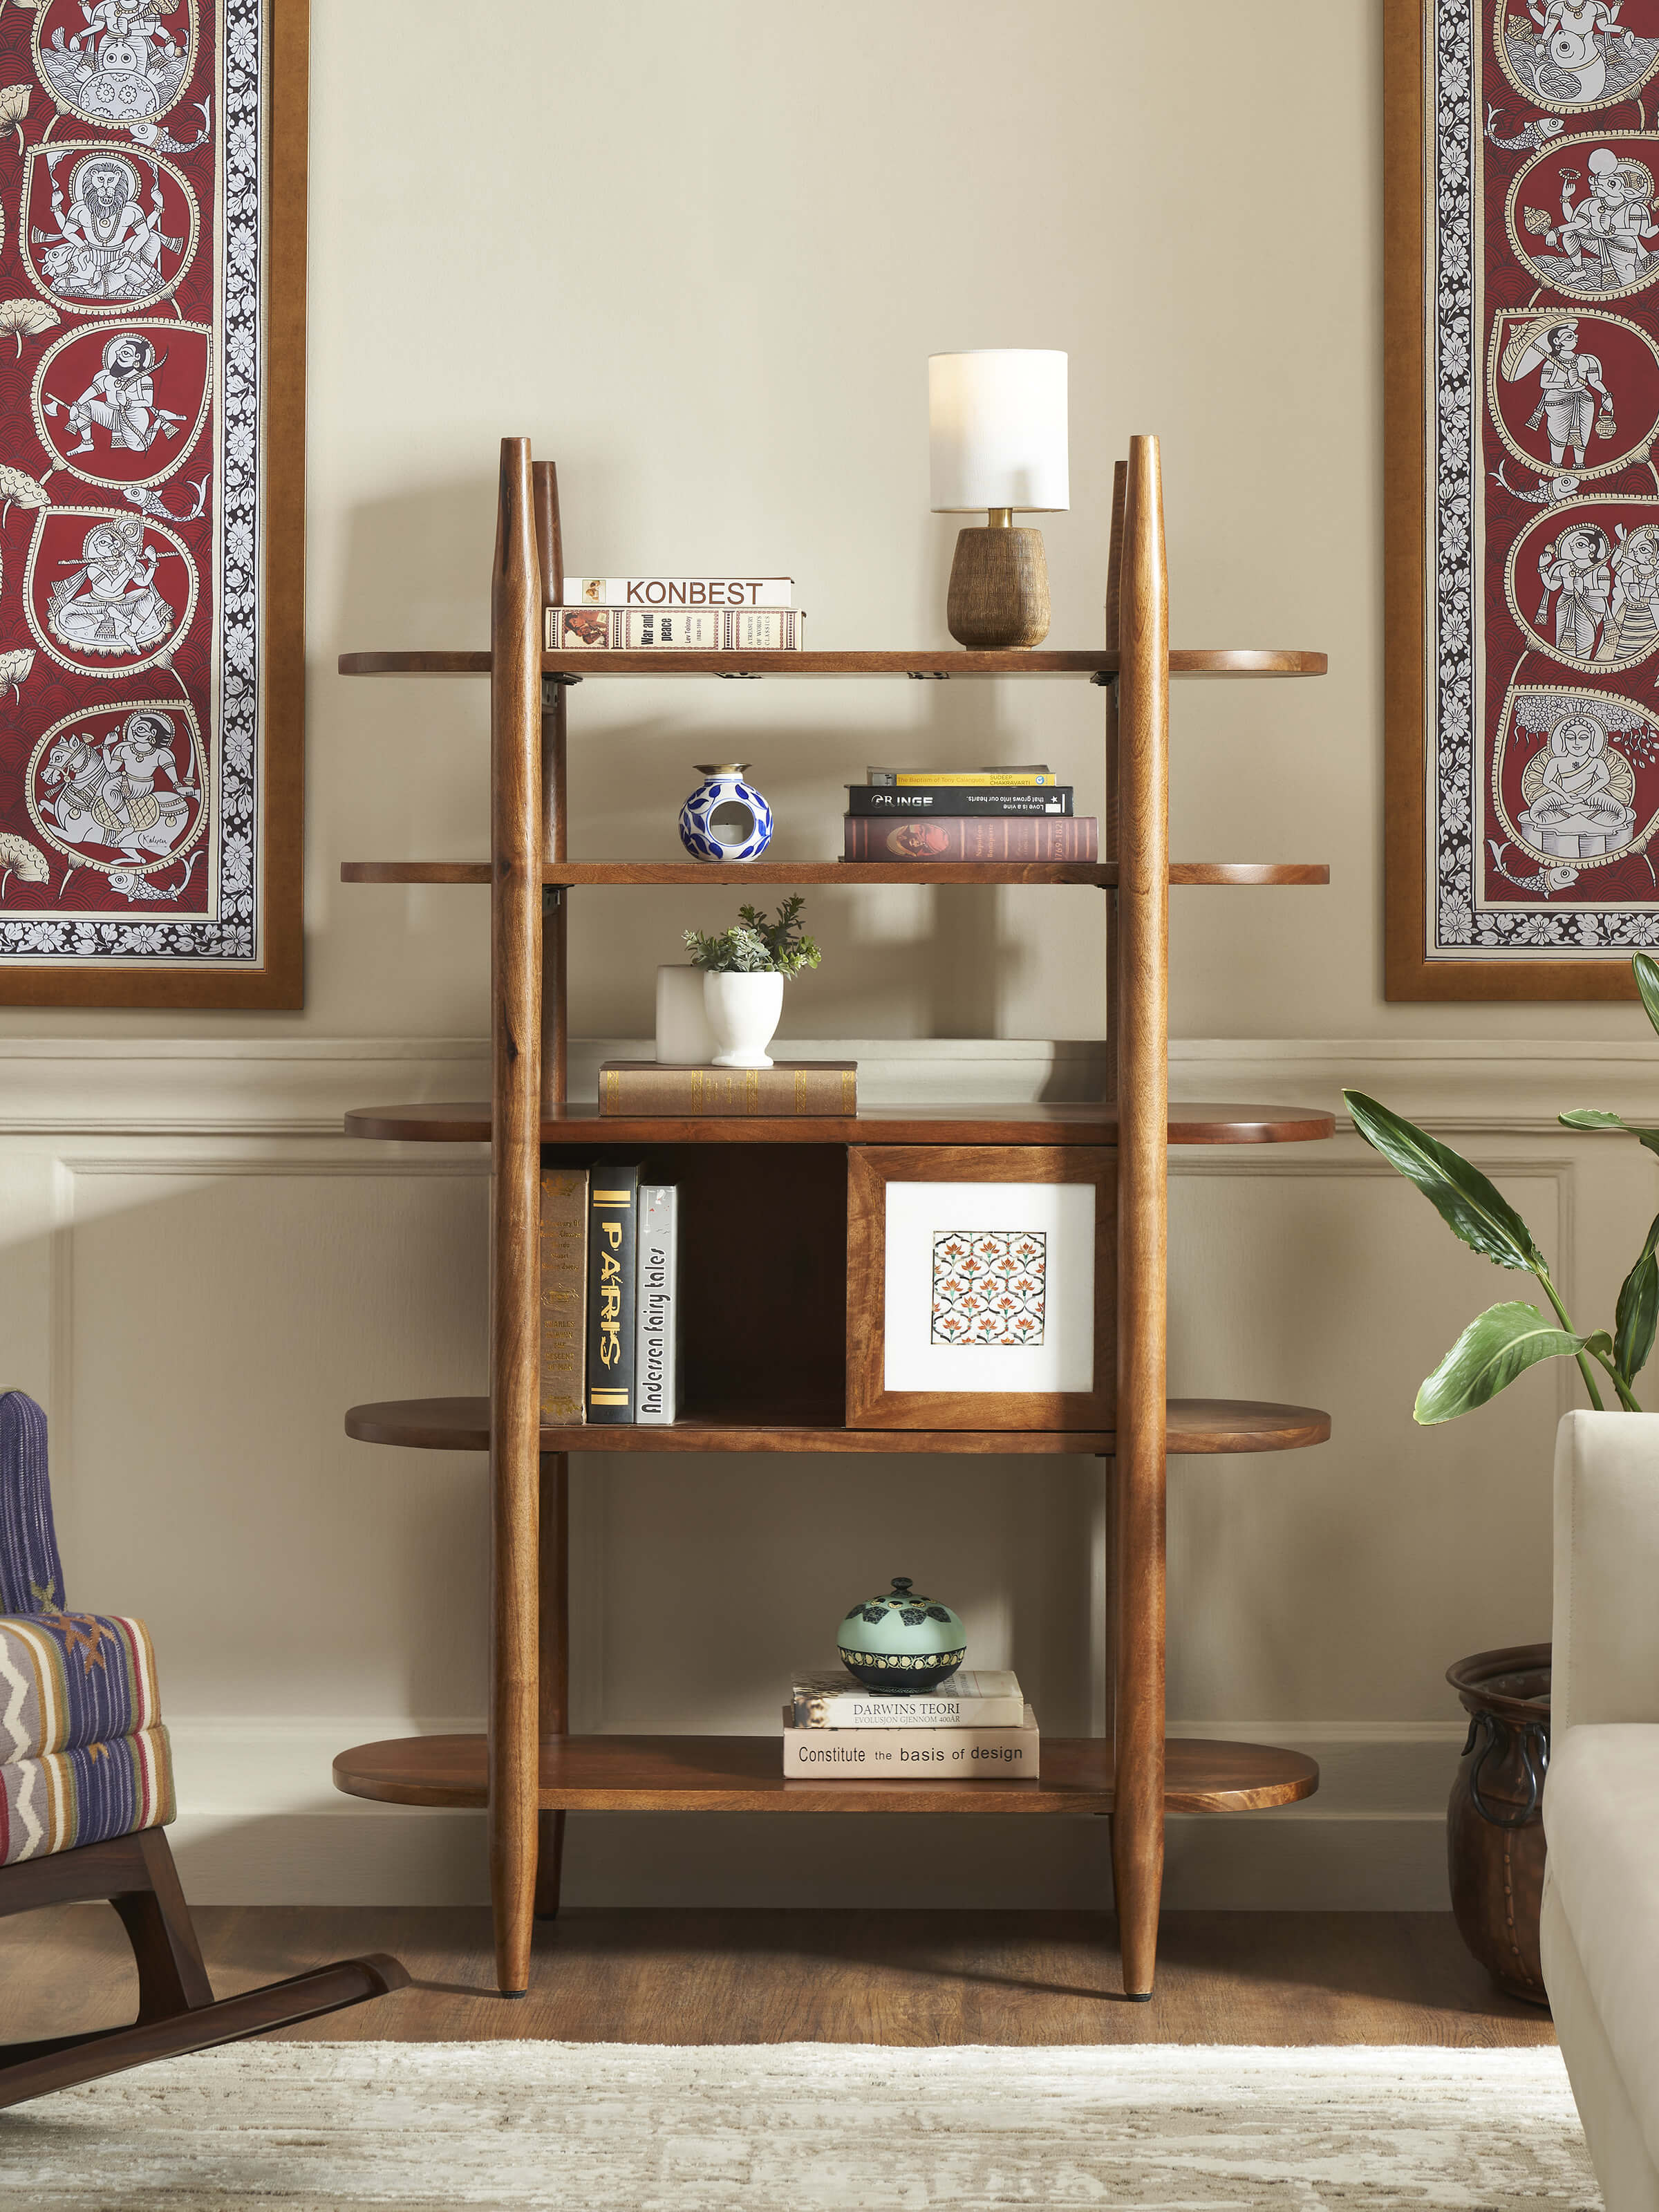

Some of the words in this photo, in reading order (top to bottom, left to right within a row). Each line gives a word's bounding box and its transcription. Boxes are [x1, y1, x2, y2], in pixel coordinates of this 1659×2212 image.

[627, 581, 763, 605] KONBEST
[641, 614, 654, 628] and
[661, 617, 673, 641] peace
[641, 628, 654, 645] War
[757, 636, 762, 646] OF
[1054, 820, 1062, 861] 1769-1821
[644, 1248, 666, 1288] tales
[643, 1293, 671, 1332] fairy
[641, 1337, 664, 1414] Andersen
[854, 1704, 917, 1715] DARWINS
[920, 1703, 960, 1714] TEORI
[854, 1716, 898, 1725] EVOLUSJON
[900, 1716, 937, 1724] GJENNOM
[798, 1747, 865, 1762] Constitute
[875, 1751, 892, 1760] the
[900, 1747, 944, 1761] basis
[952, 1748, 965, 1760] of
[971, 1746, 1023, 1763] design
